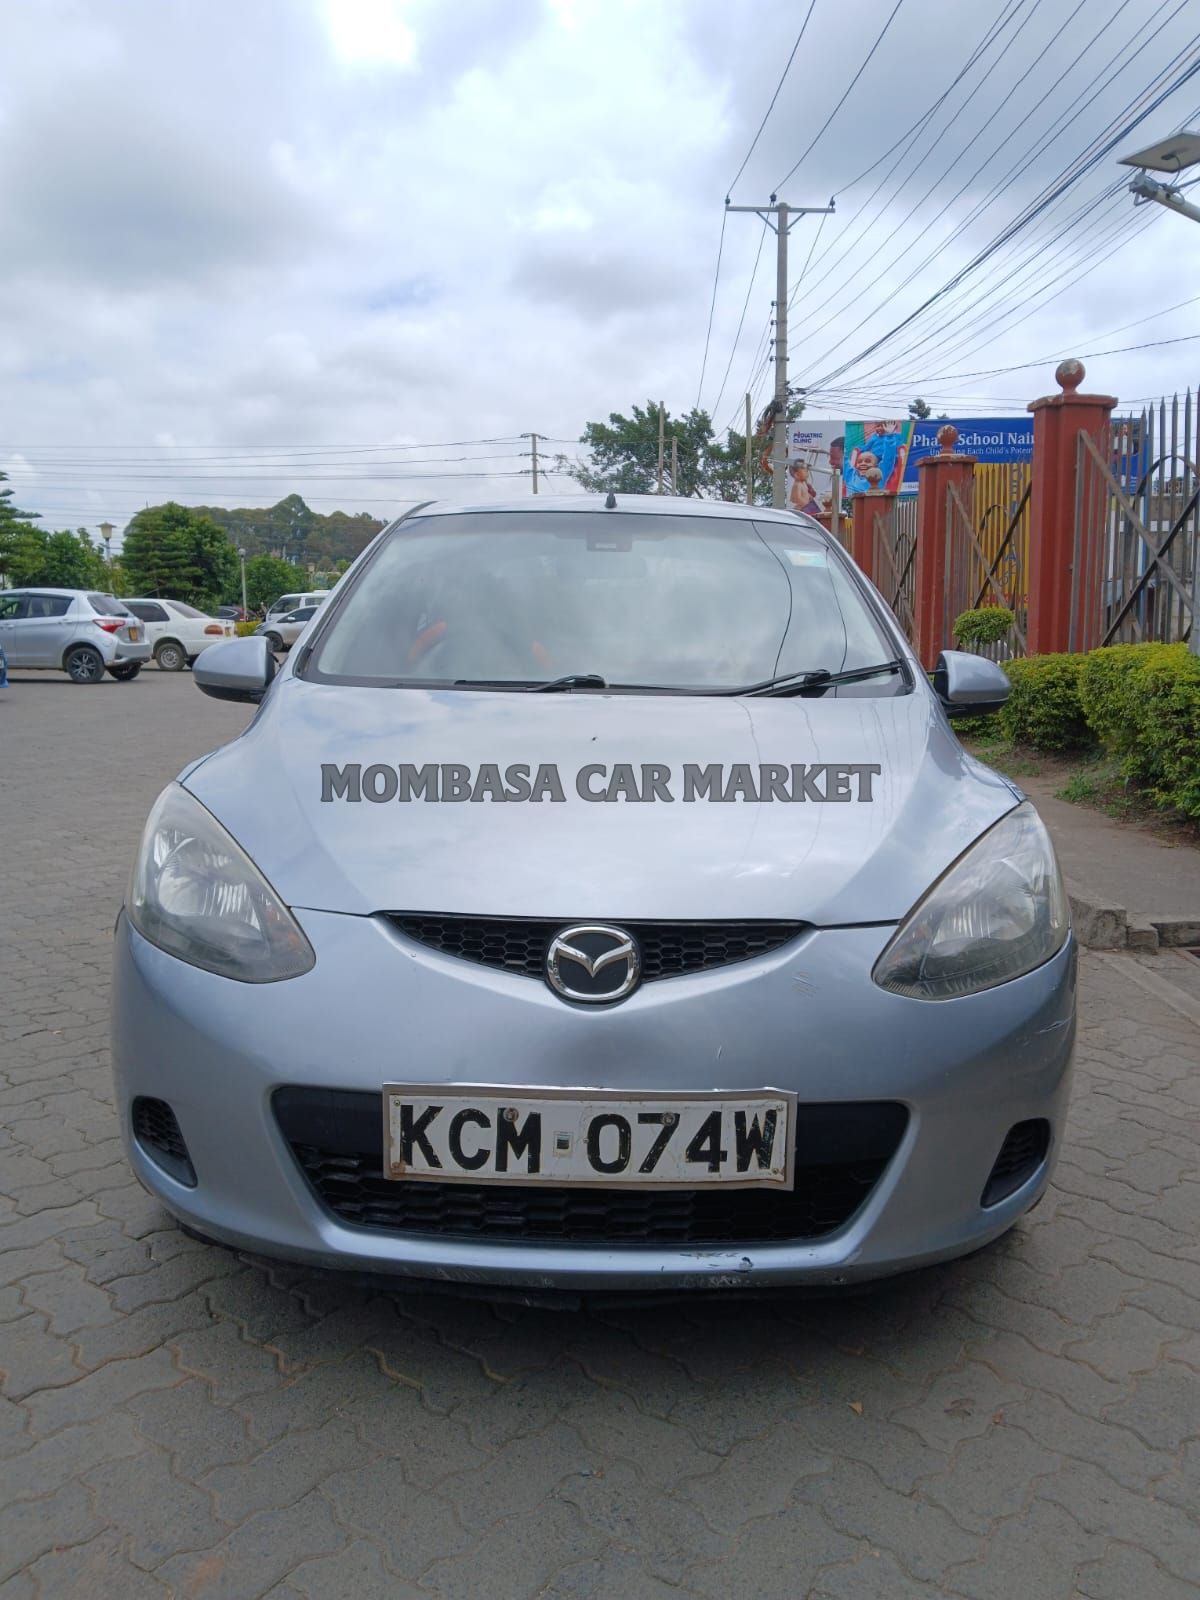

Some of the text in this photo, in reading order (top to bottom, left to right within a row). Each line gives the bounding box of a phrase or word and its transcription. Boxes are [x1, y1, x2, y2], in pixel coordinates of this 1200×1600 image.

[957, 431, 1004, 446] School
[967, 447, 984, 455] Each
[985, 446, 1009, 454] Child's
[400, 1104, 778, 1174] KCM 074W
